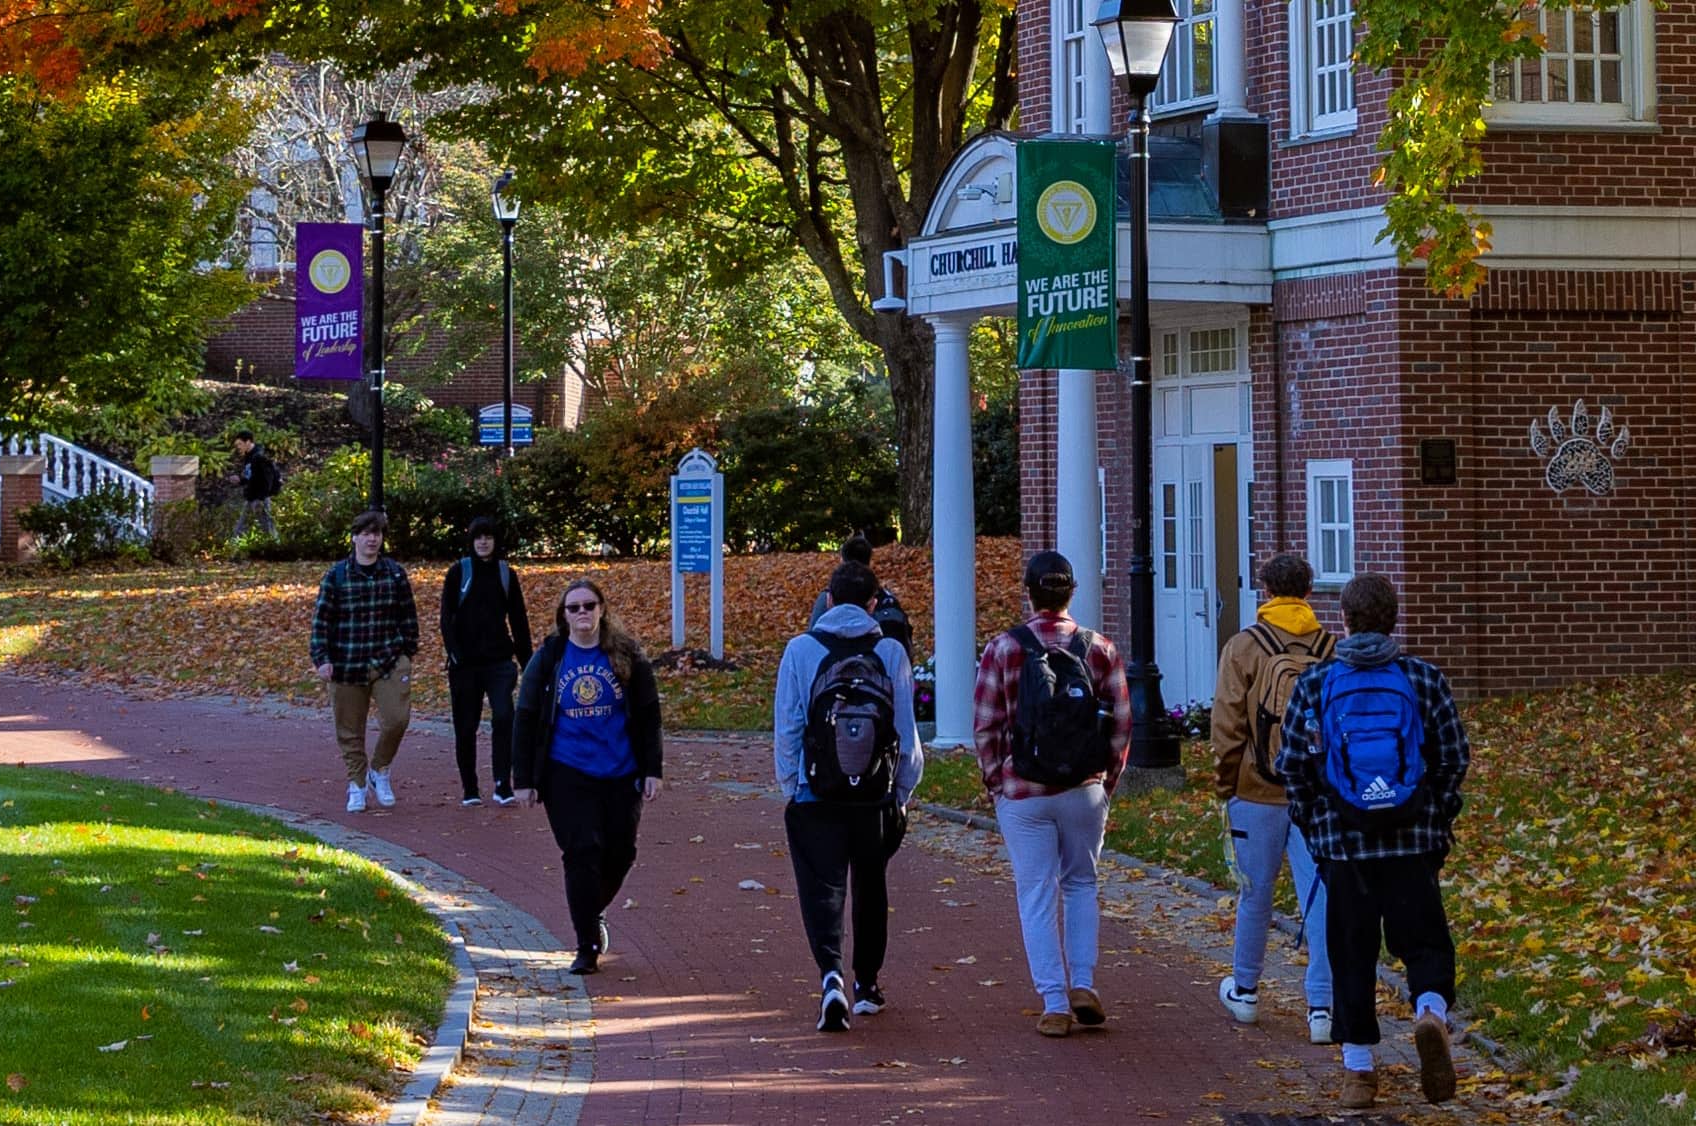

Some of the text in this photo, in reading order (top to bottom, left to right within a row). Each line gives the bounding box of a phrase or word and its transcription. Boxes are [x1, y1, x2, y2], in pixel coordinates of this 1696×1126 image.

[931, 241, 1017, 276] CHURCHILL HA
[1026, 269, 1109, 293] WE ARE THE
[1027, 285, 1109, 318] FUTURE
[301, 310, 358, 327] WE ARE THE
[1027, 313, 1108, 345] of Innovation
[302, 321, 358, 343] FUTURE
[1362, 790, 1396, 800] adidas
